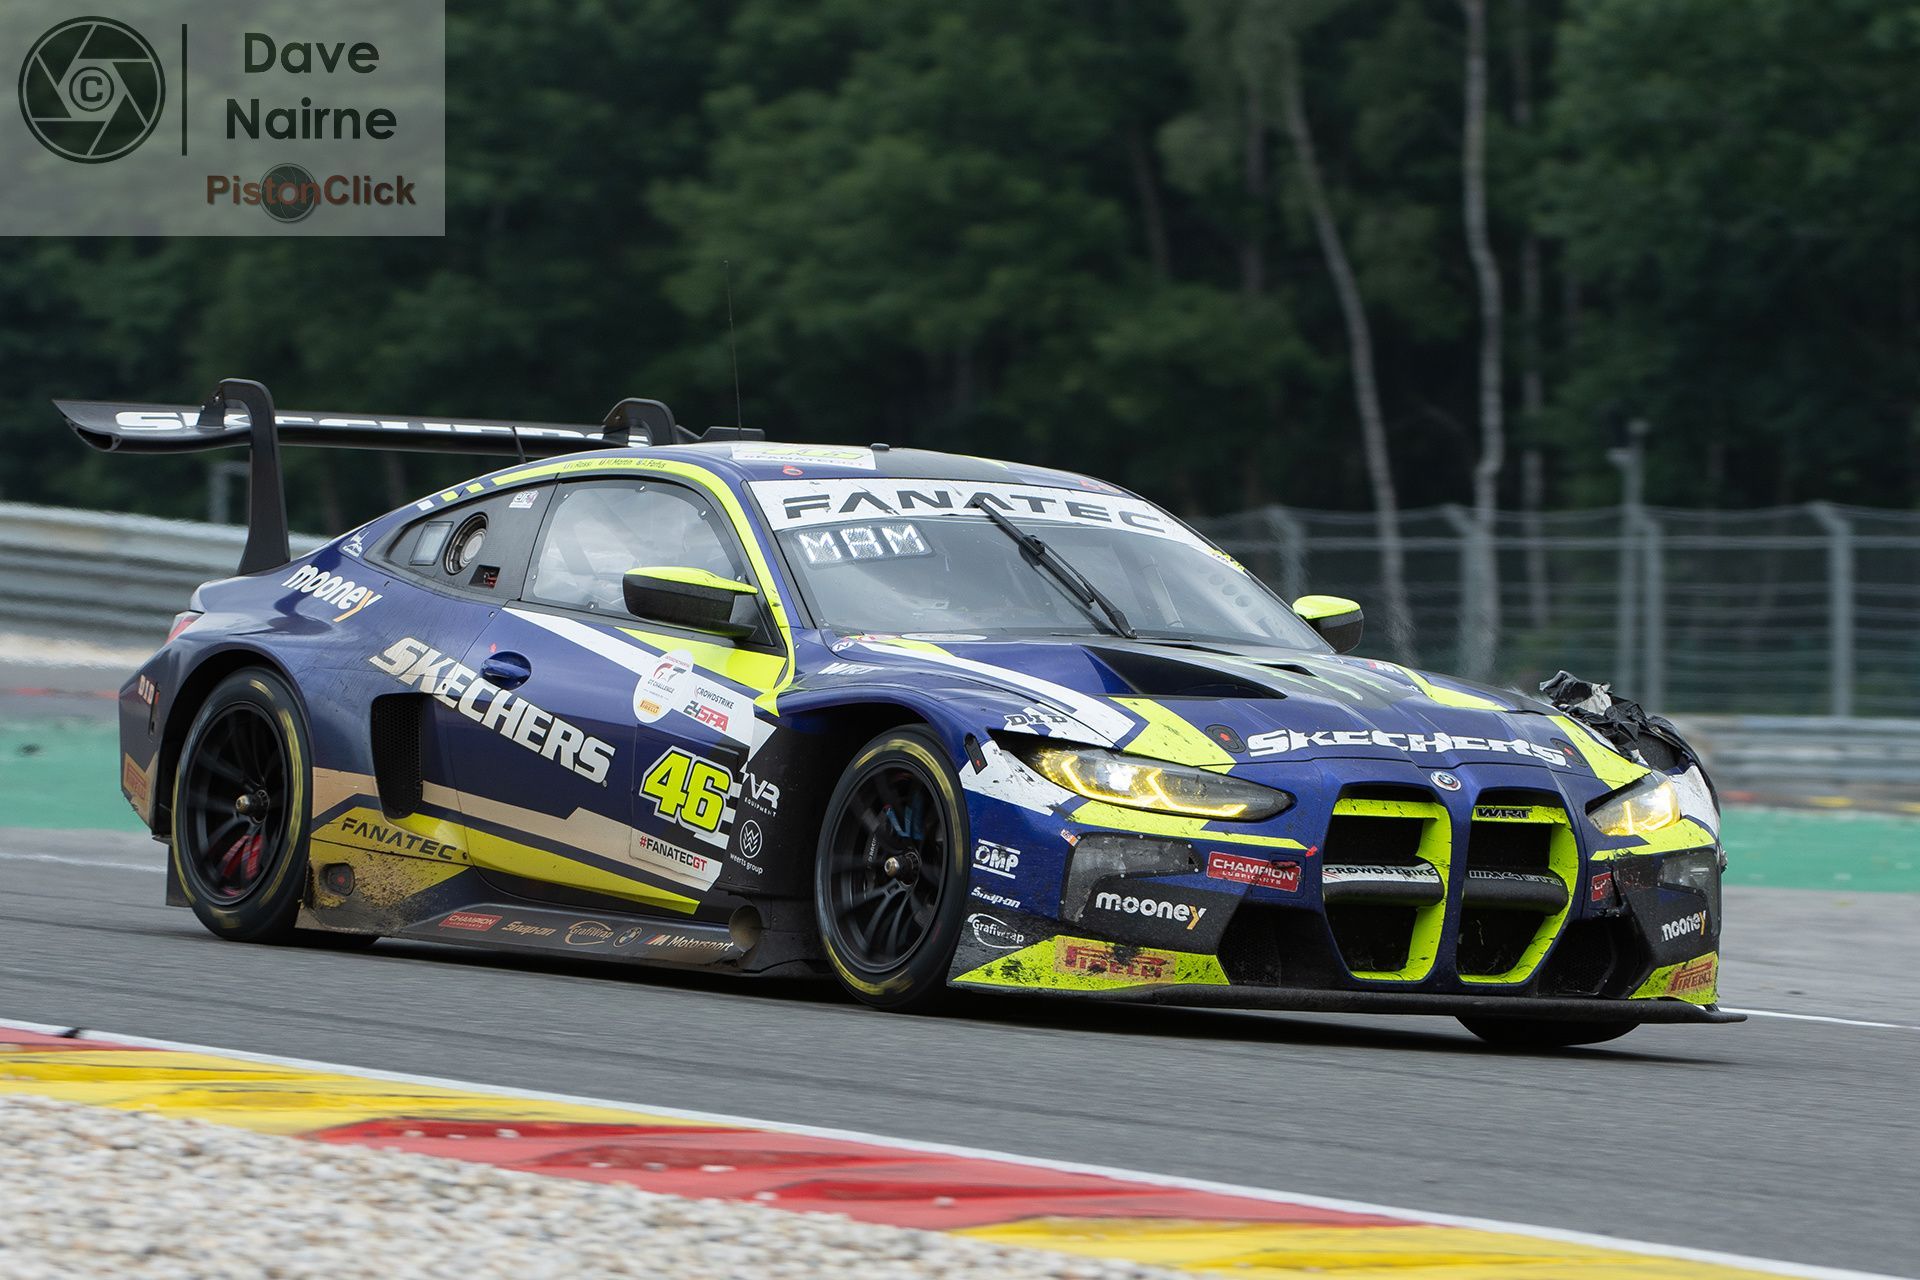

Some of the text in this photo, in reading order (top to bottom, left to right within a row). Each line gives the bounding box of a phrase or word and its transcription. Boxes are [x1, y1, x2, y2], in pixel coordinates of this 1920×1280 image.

[782, 489, 1166, 534] FANATEC
[281, 564, 383, 622] mooney
[369, 637, 616, 784] SKECHERS
[697, 687, 735, 710] CROWDSTRIKE
[1247, 729, 1567, 768] SKECHERS
[639, 746, 734, 838] 46
[341, 817, 457, 860] FANATEC
[639, 835, 708, 872] #FANATECGT
[746, 860, 764, 875] group
[975, 845, 1020, 872] OMP
[1212, 858, 1295, 881] CHAMPION
[1324, 866, 1438, 878] CROWDSTRIKE
[1095, 891, 1207, 930] mooney
[1661, 910, 1707, 943] mooney
[501, 921, 557, 937] Snap-on
[668, 935, 734, 952] Motorsport
